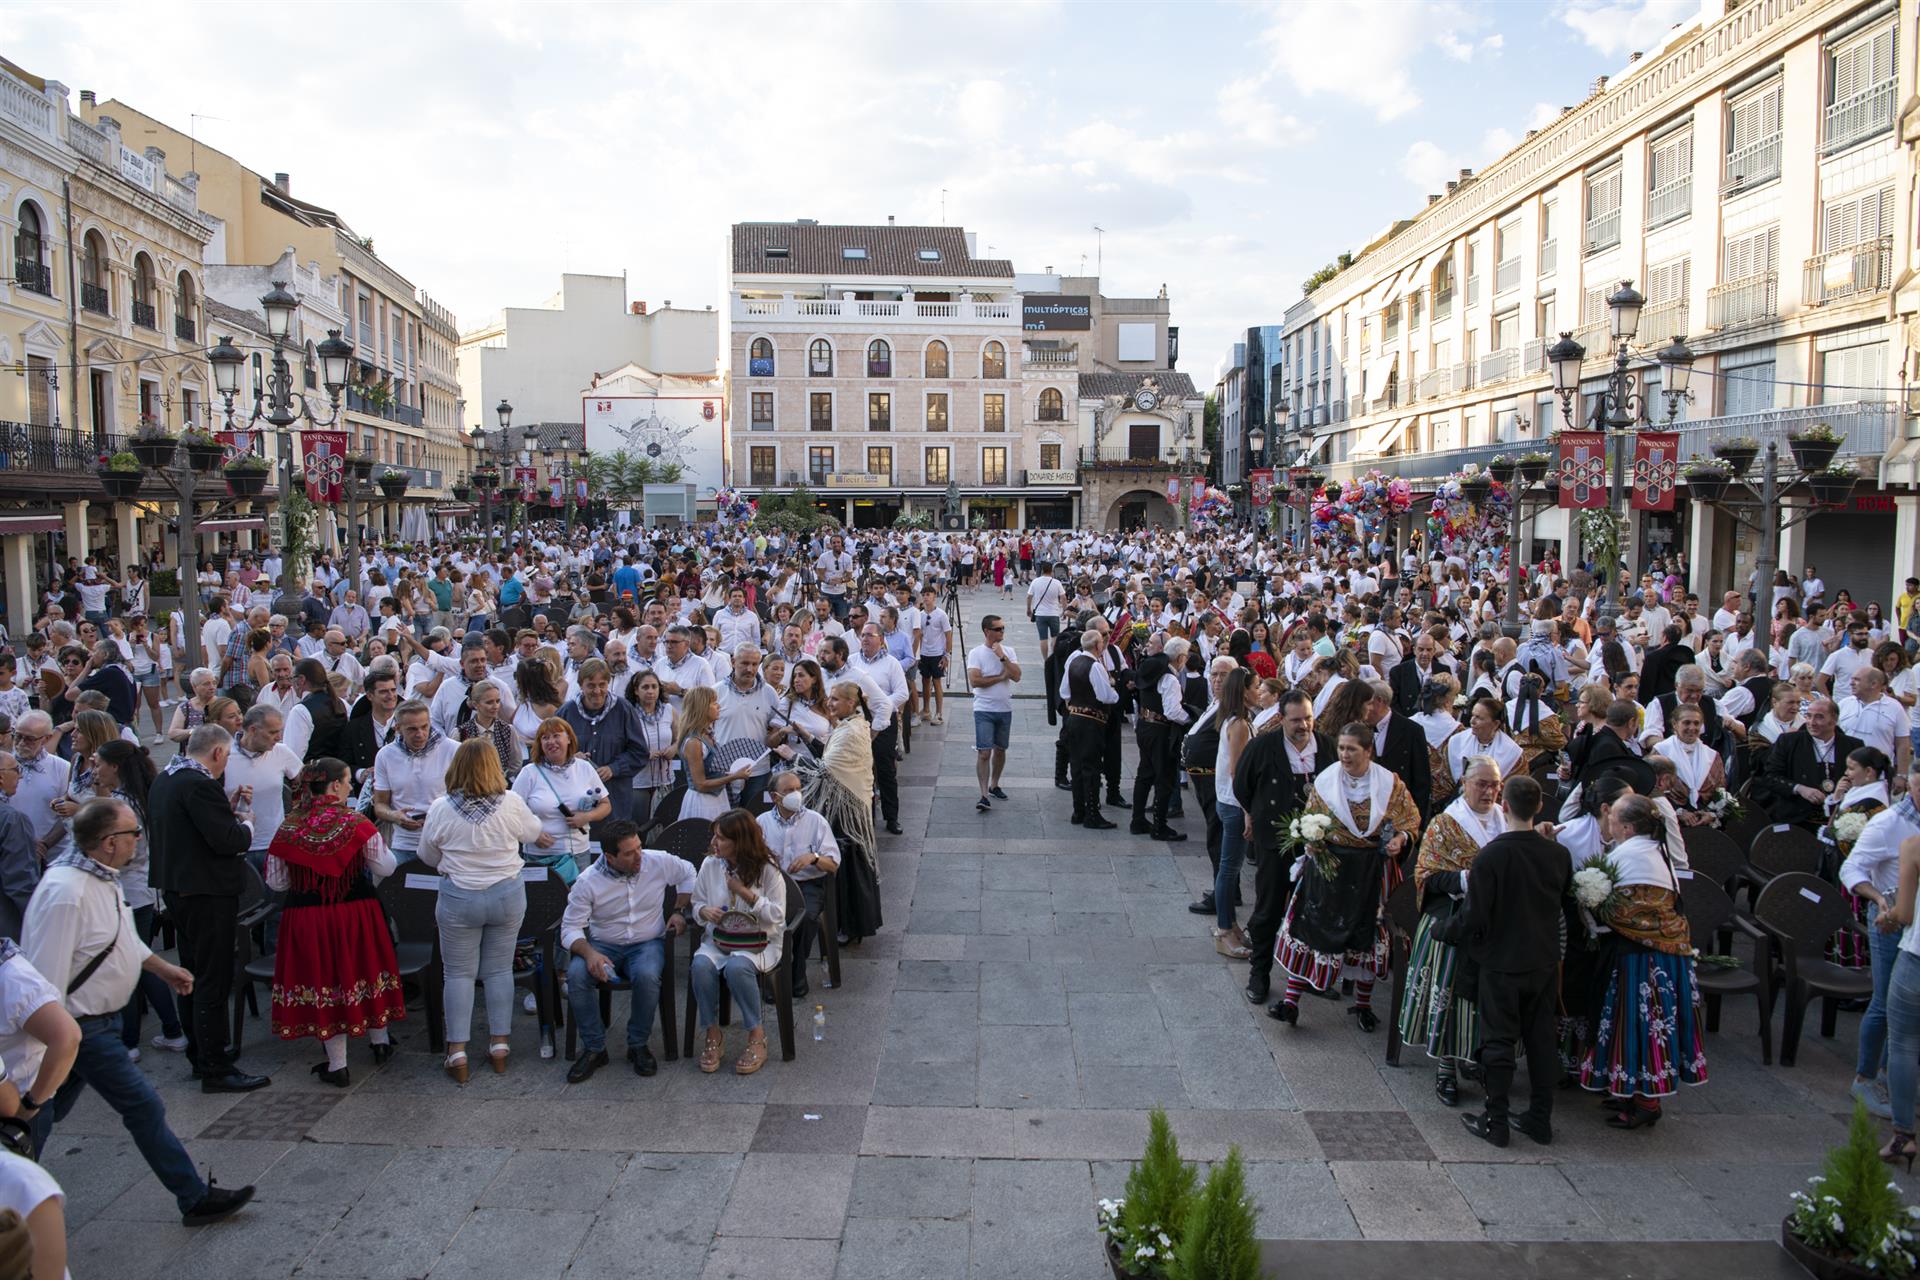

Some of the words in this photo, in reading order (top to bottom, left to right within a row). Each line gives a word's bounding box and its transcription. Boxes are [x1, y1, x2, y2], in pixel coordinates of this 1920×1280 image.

[303, 434, 343, 443] PANDORGA
[1562, 438, 1601, 446] PANDORGA
[1638, 440, 1675, 448] PANDORGA
[1030, 472, 1054, 481] DONAIRE
[1056, 472, 1075, 481] MATEO
